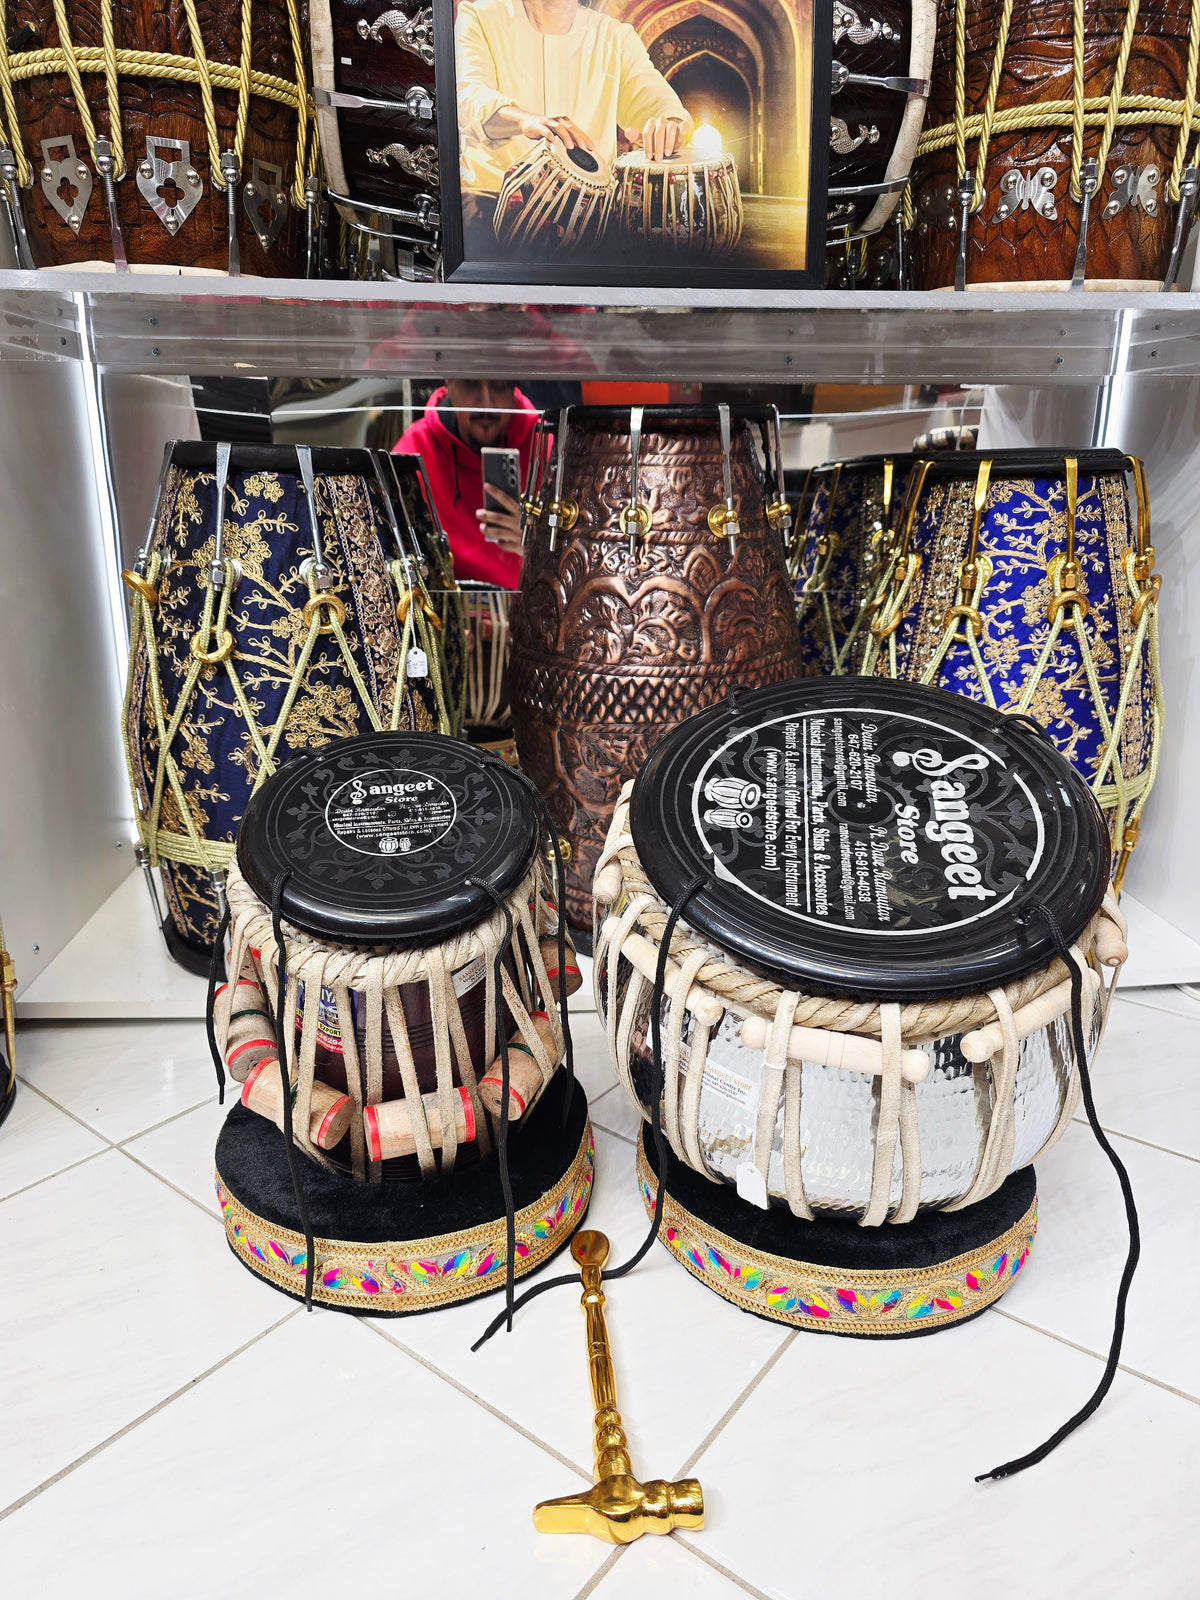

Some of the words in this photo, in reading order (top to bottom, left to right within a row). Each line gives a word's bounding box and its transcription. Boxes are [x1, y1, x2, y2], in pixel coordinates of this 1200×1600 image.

[782, 722, 800, 749] Repairs
[810, 718, 826, 746] Musical
[784, 758, 800, 788] Lessons
[848, 734, 863, 791] 647-620-2107
[350, 779, 435, 805] Sangeet
[863, 753, 881, 803] Ramoutar
[385, 796, 418, 804] Store
[761, 748, 781, 871] (www.sangeetstore.com)
[784, 789, 801, 819] Offered
[810, 801, 828, 825] Parts,
[784, 820, 801, 834] For
[813, 828, 830, 851] Skins
[868, 825, 888, 839] Pt.
[892, 749, 997, 901] Sangeet
[894, 803, 920, 865] Store
[781, 835, 801, 859] Every
[813, 853, 831, 861] &
[870, 841, 889, 867] Dave
[785, 860, 802, 907] Instrument
[854, 841, 872, 903] 416-918-4038
[814, 862, 833, 916] Accessories
[873, 868, 893, 922] Ramoutar
[706, 1063, 733, 1083] SANGEET
[733, 1077, 753, 1093] STORE
